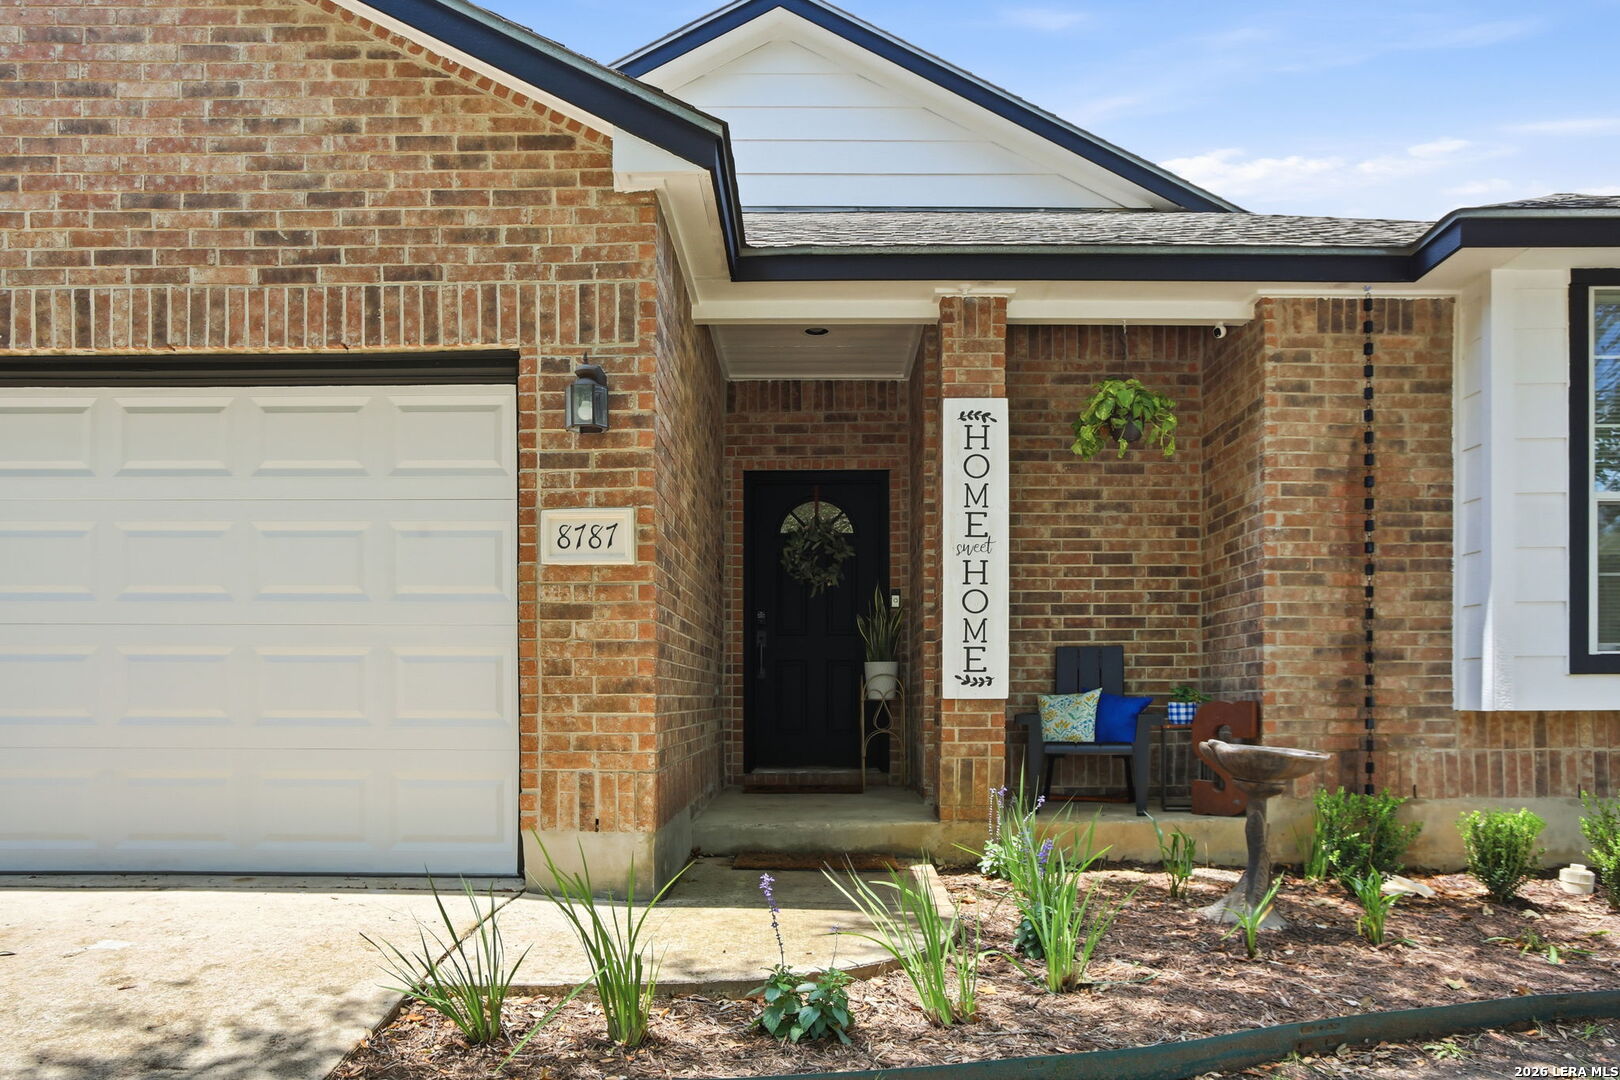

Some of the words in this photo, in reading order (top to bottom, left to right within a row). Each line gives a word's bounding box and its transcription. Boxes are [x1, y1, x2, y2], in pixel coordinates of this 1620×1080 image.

[963, 425, 990, 537] HOME
[557, 522, 618, 550] 8787
[955, 536, 995, 556] sweet
[962, 560, 989, 672] HOME
